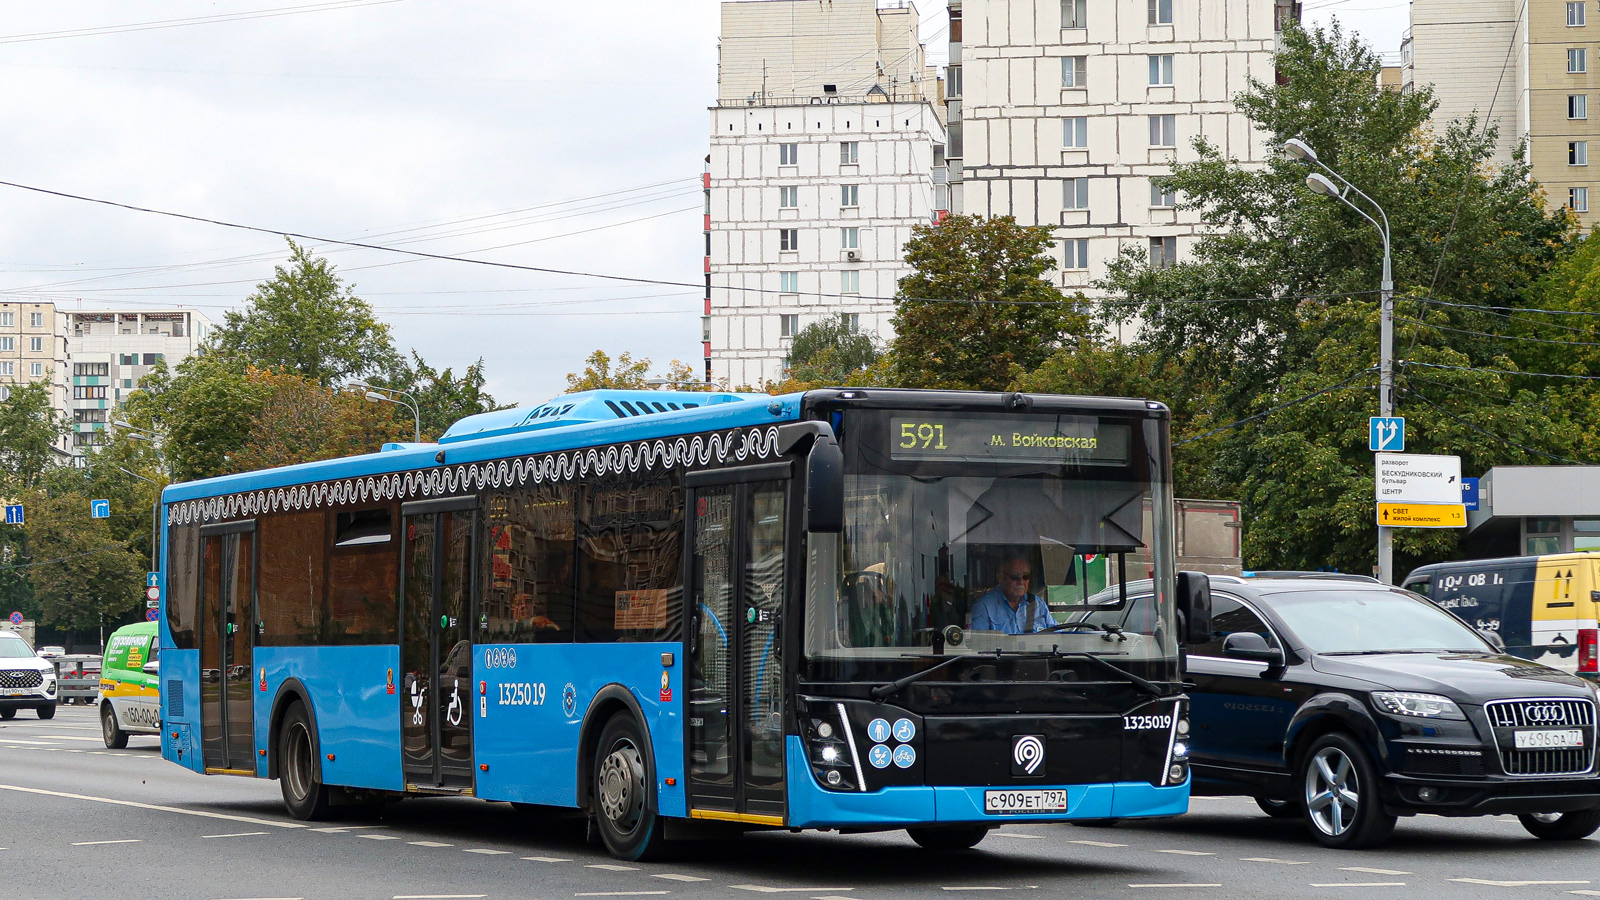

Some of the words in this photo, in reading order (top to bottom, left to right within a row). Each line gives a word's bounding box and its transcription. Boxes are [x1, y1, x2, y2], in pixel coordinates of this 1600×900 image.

[900, 423, 947, 450] 591
[990, 434, 1006, 446] м.
[1012, 432, 1098, 449] Войковская
[1382, 470, 1443, 478] БЕСКУДНИКОВСКИЙ
[498, 682, 546, 706] 1325019
[1123, 715, 1171, 730] 1325019
[1043, 791, 1063, 803] 797
